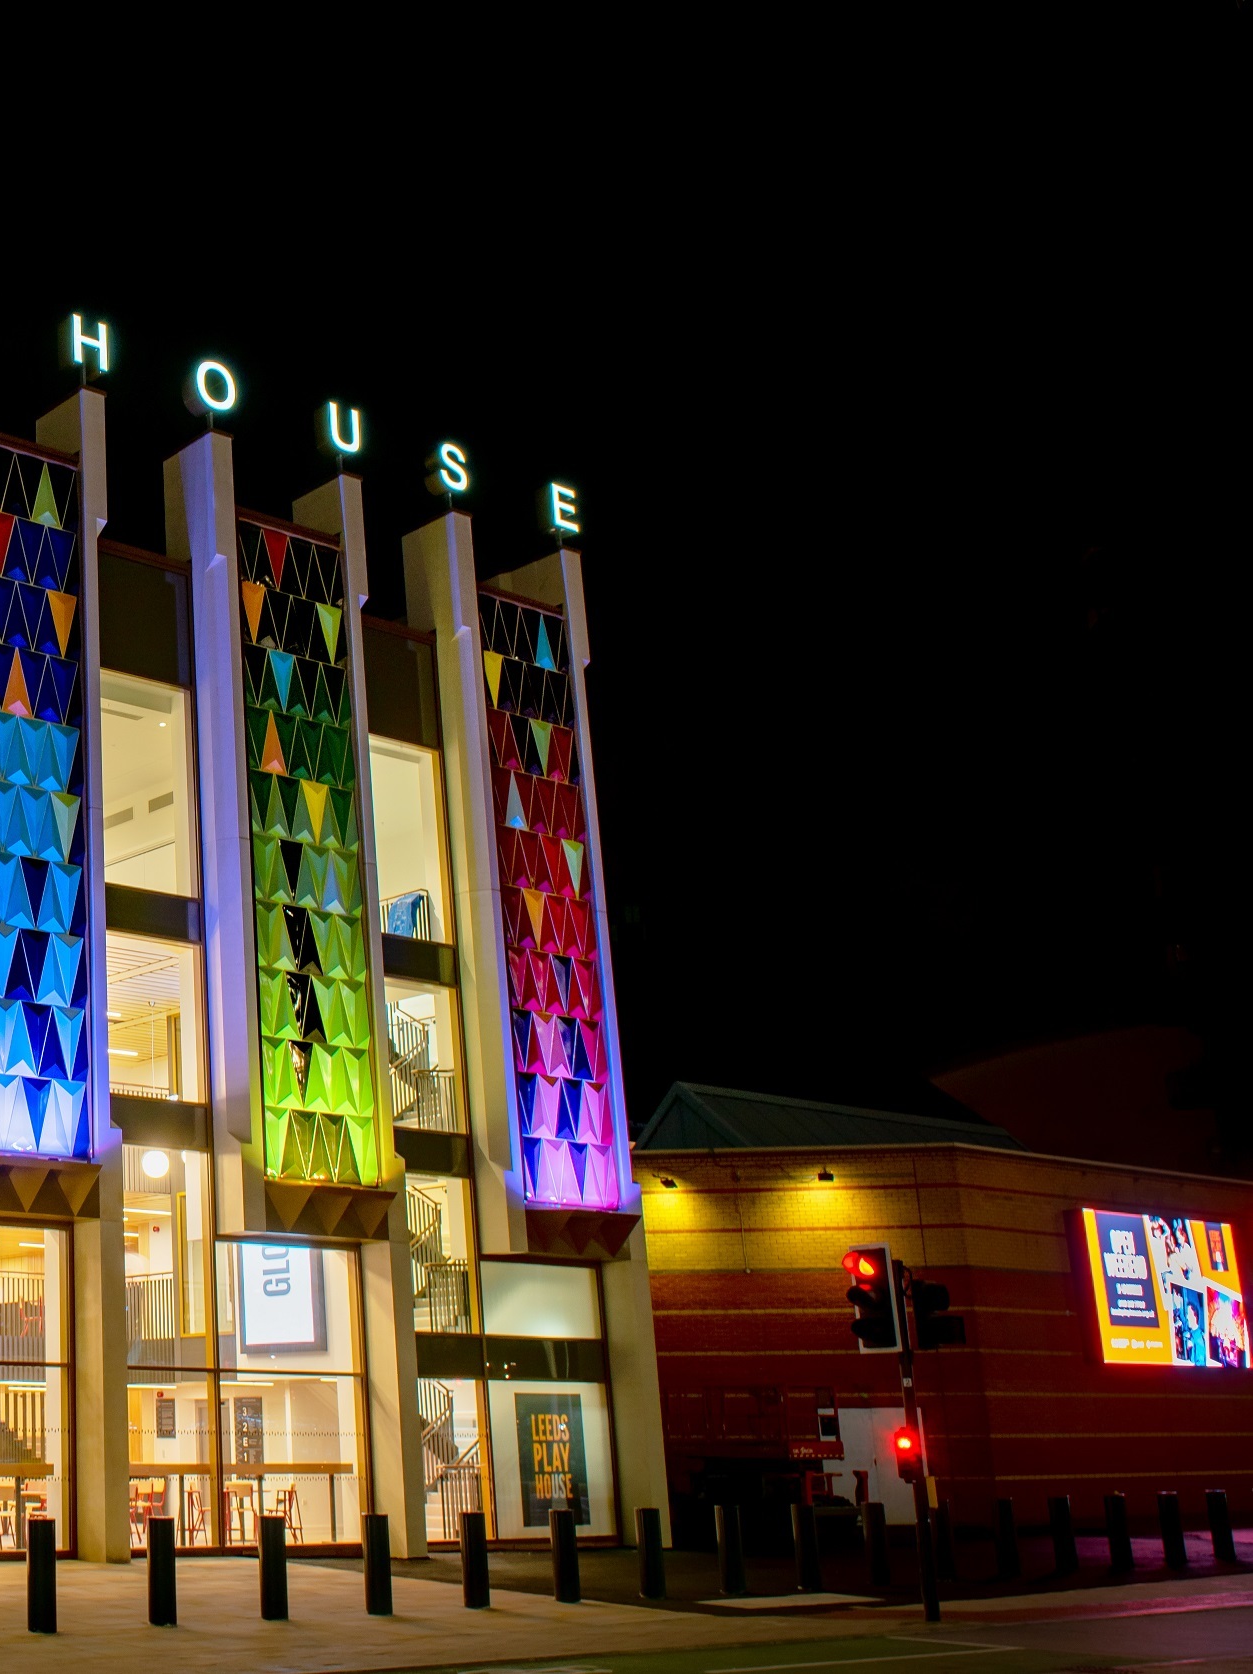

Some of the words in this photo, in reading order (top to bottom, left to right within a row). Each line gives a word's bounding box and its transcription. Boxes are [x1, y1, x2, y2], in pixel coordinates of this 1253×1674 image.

[242, 1406, 247, 1417] 3
[242, 1421, 248, 1432] 2
[531, 1413, 570, 1442] LEEDS
[533, 1441, 570, 1473] PLAY
[535, 1473, 573, 1499] HOUSE
